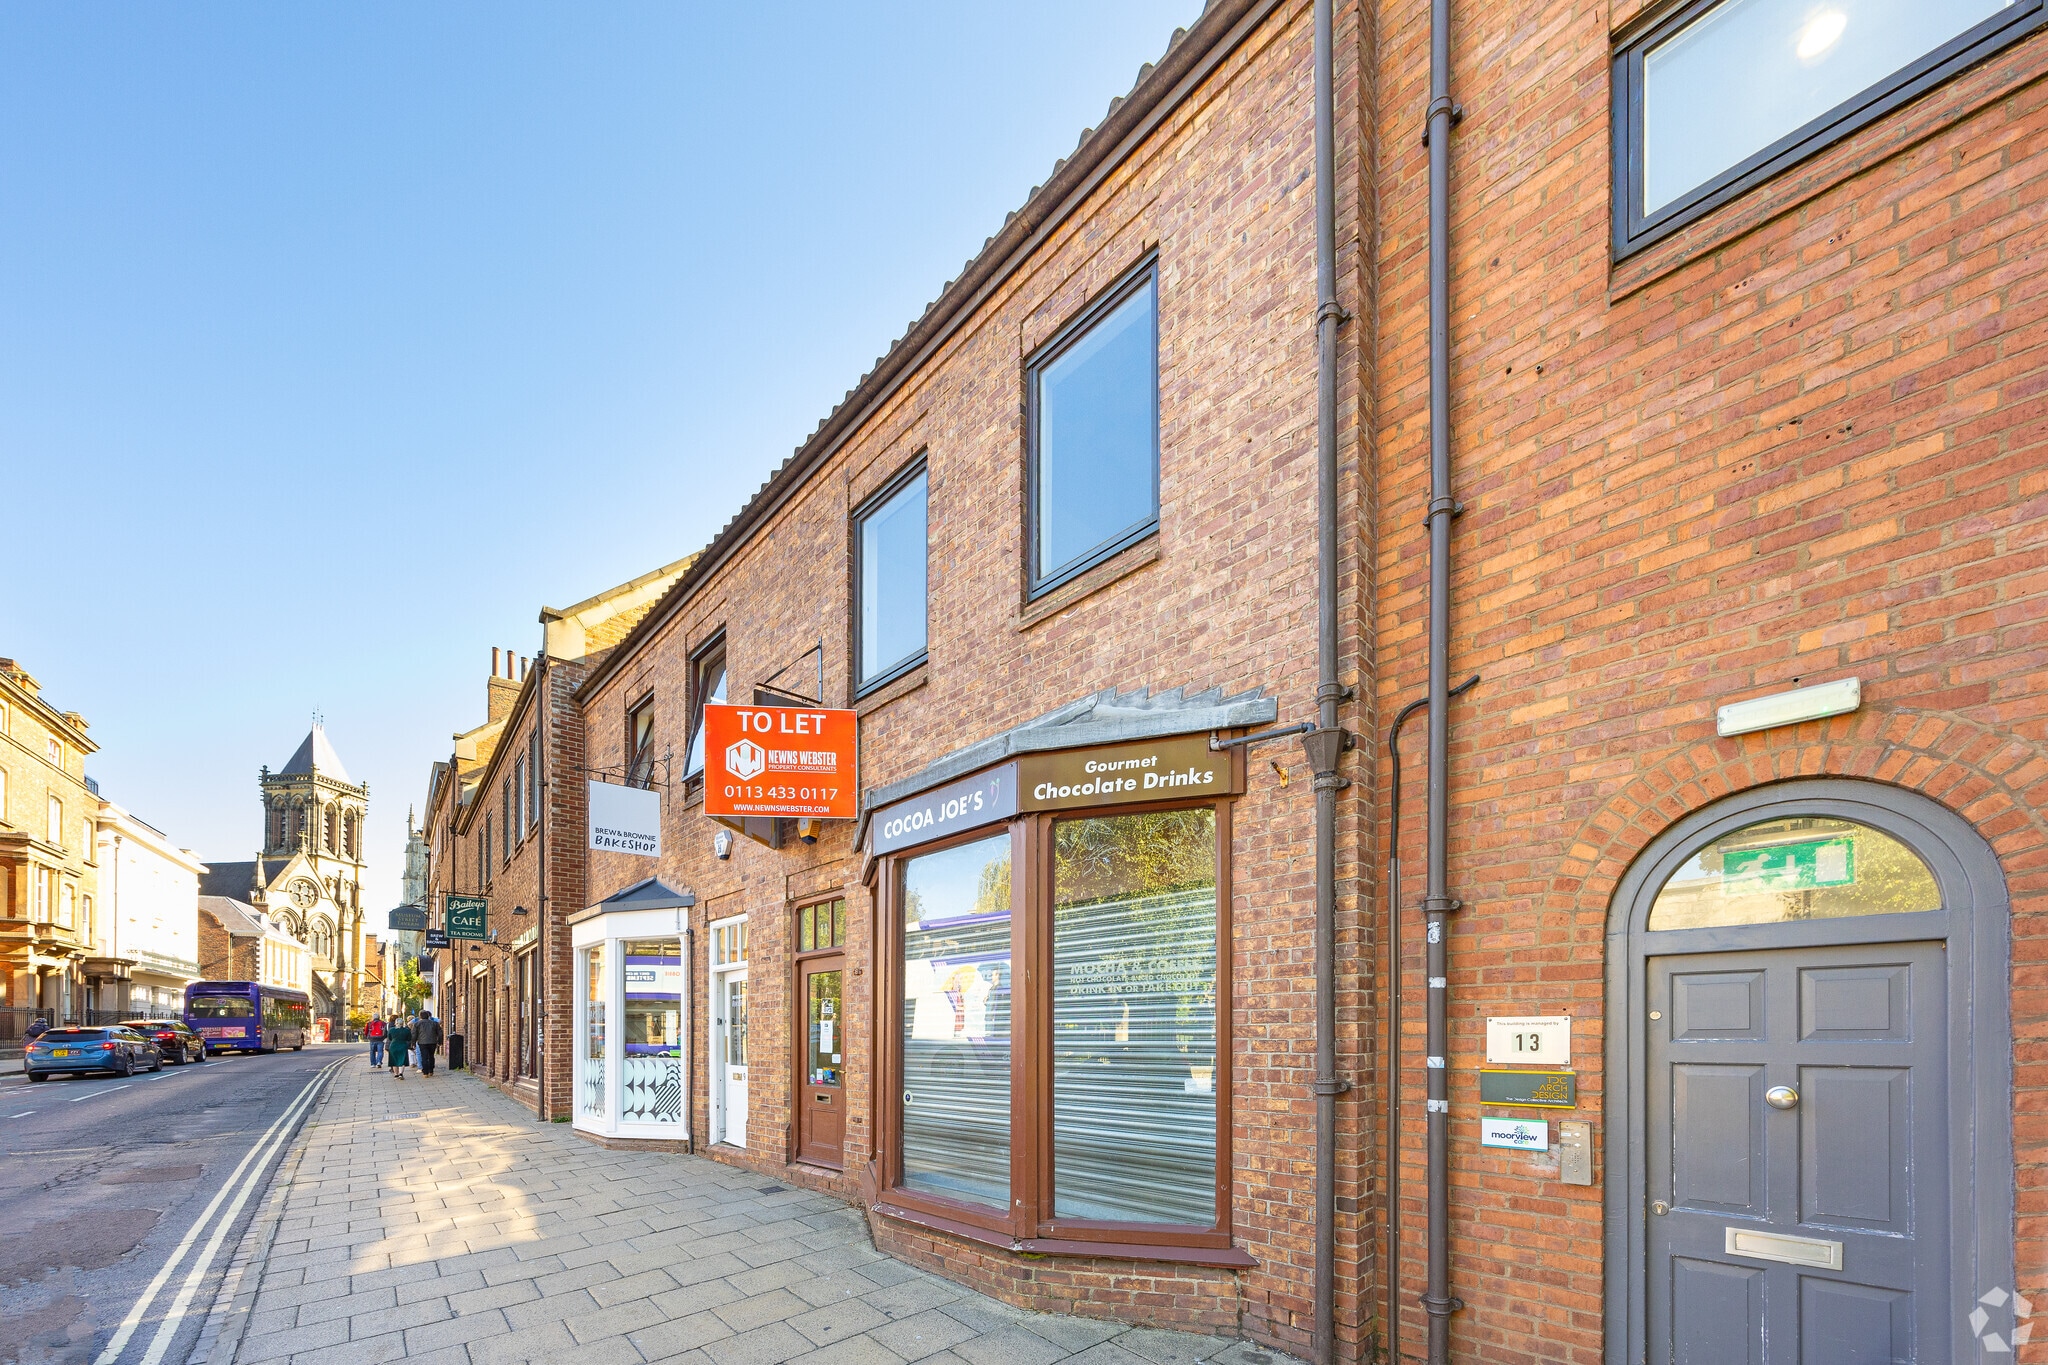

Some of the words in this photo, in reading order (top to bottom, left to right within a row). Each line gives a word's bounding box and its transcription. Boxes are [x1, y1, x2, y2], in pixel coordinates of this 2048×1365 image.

[736, 711, 772, 733] TO
[780, 713, 826, 734] LET
[768, 750, 798, 765] NEWNS
[800, 750, 836, 766] WEBSTER
[1084, 755, 1158, 774] Gourmet
[1033, 777, 1137, 801] Chocolate
[1142, 767, 1214, 790] Drinks
[724, 786, 763, 798] 0113
[767, 786, 796, 799] 433
[800, 788, 838, 800] 0117
[733, 804, 830, 814] WWW.NEWNSWEBSTER.COM
[883, 806, 934, 840] COCOA
[938, 790, 984, 824] JOE'S
[595, 827, 617, 836] BREW
[624, 832, 656, 842] BROWNIE
[595, 835, 656, 852] BAKESHOP
[449, 900, 486, 910] Baileys
[452, 916, 482, 926] CAFÉ
[1070, 961, 1125, 974] MOCHA
[1132, 961, 1140, 971] &
[1070, 986, 1106, 994] DRINK
[1126, 984, 1139, 993] OR
[1539, 1084, 1568, 1092] ARCH
[1532, 1091, 1568, 1100] DESIGN
[1492, 1132, 1538, 1141] moorview
